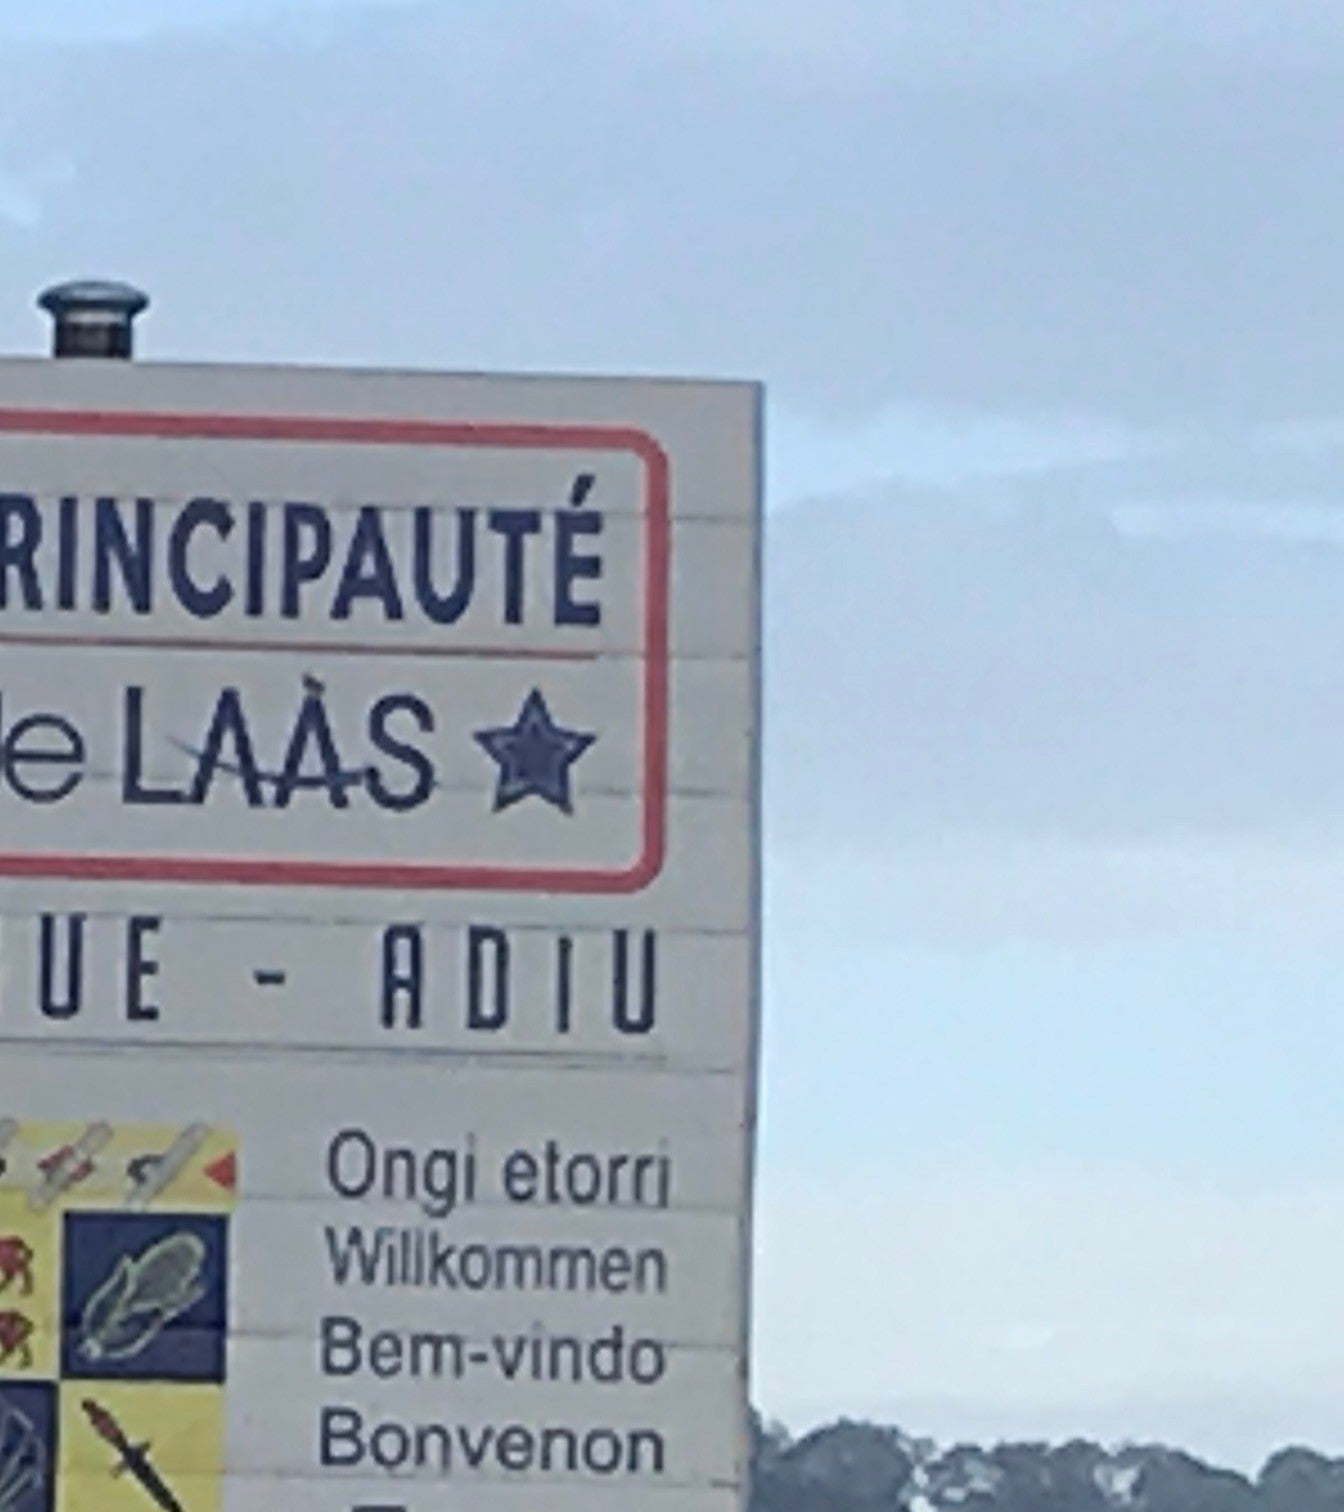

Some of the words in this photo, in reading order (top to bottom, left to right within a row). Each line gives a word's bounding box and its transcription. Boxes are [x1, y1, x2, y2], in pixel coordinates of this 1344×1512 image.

[380, 922, 660, 1034] ADIU
[326, 1128, 478, 1218] Ongi
[502, 1138, 672, 1208] etorri
[324, 1224, 668, 1294] Willkommen
[320, 1316, 666, 1386] Bem-vindo
[320, 1406, 666, 1474] Bonvenon
